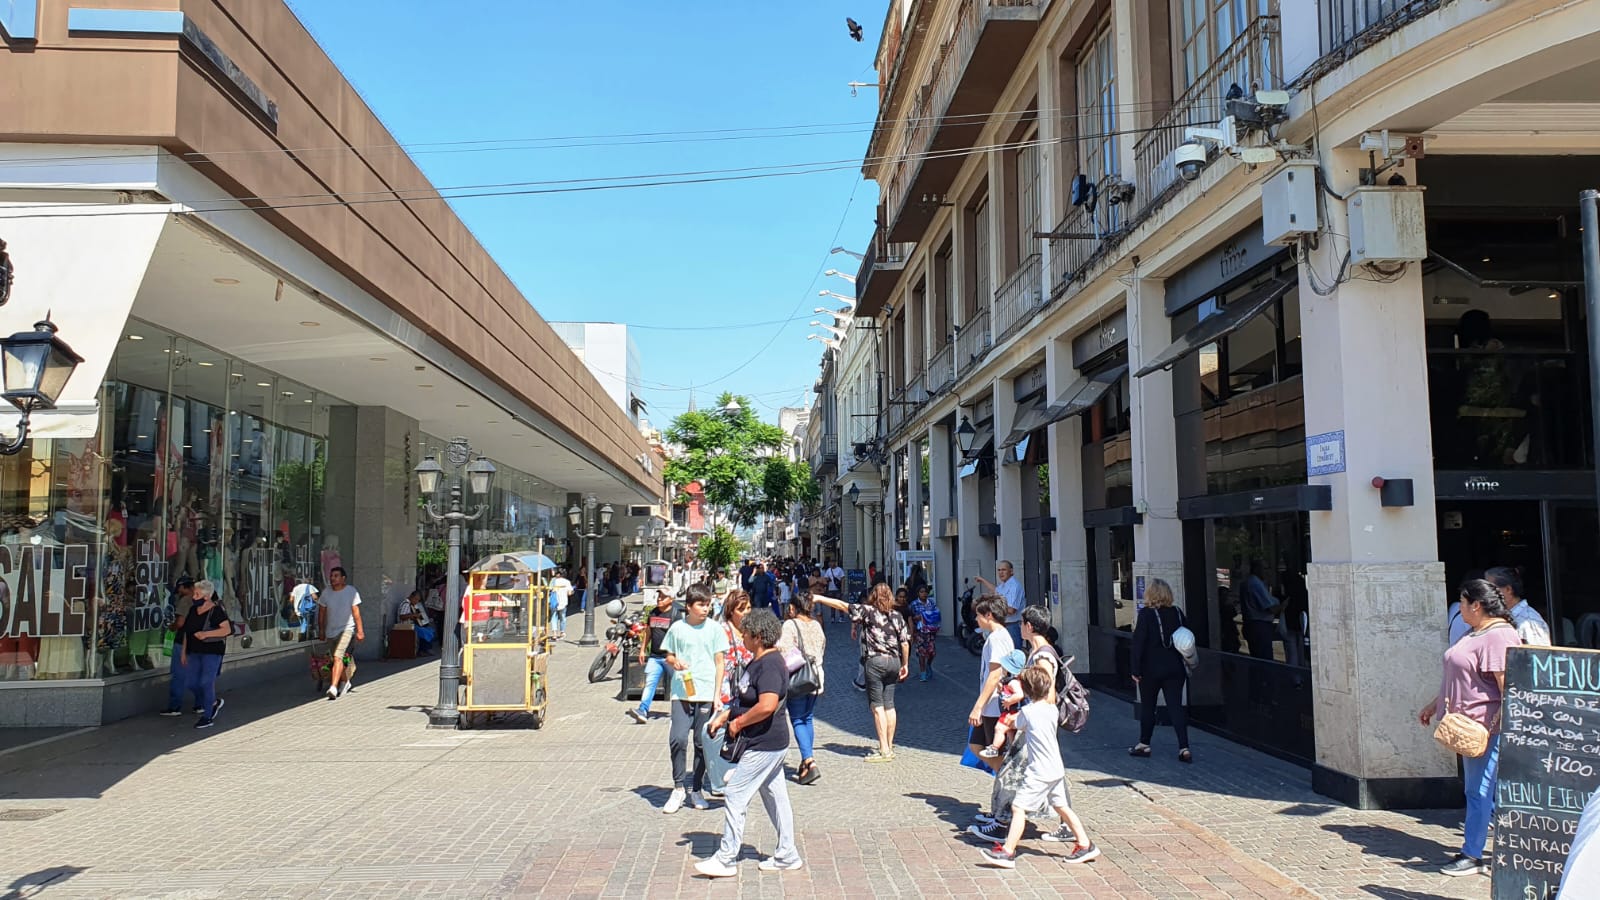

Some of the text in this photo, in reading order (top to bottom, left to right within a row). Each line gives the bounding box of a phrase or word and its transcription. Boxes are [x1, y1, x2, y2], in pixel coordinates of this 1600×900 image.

[1464, 480, 1500, 491] time
[137, 539, 156, 562] LI
[136, 561, 169, 585] QUI
[0, 544, 88, 640] SALE
[135, 584, 162, 607] DA
[1532, 653, 1600, 692] MENU
[1508, 686, 1600, 711] SUPREMA DE
[1508, 702, 1582, 726] POLLO CON
[1503, 732, 1549, 746] FRESCA
[1556, 741, 1577, 751] DEL
[1510, 719, 1584, 741] ENSALADA
[1499, 780, 1541, 805] MENU
[1508, 810, 1578, 835] PLATO DE
